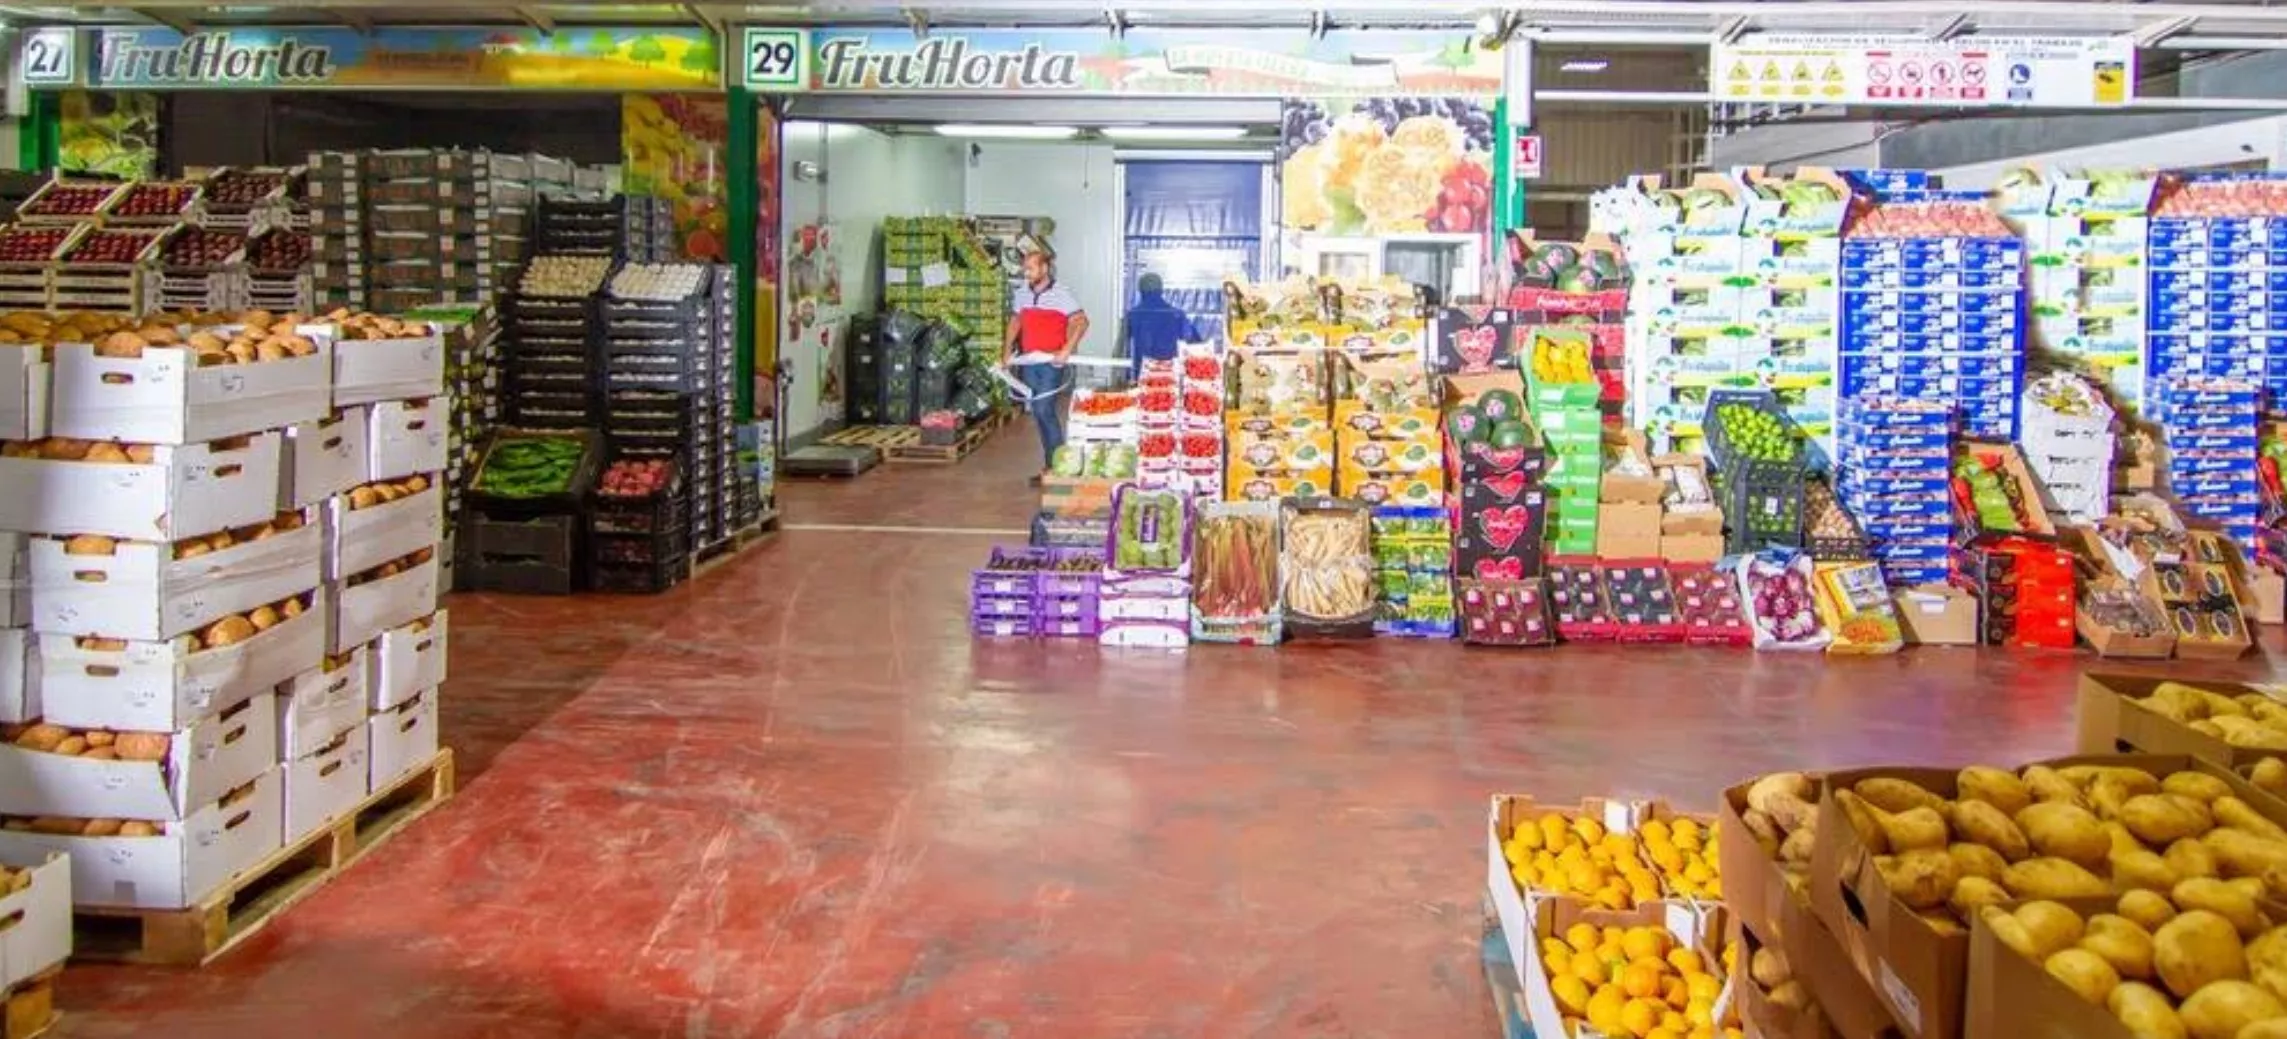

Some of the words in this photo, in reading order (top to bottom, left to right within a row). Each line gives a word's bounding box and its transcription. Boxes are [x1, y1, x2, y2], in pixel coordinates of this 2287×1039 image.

[29, 39, 65, 73] 27
[100, 32, 333, 80] FruHorta
[752, 41, 795, 74] 29
[820, 36, 1078, 86] FruHorta
